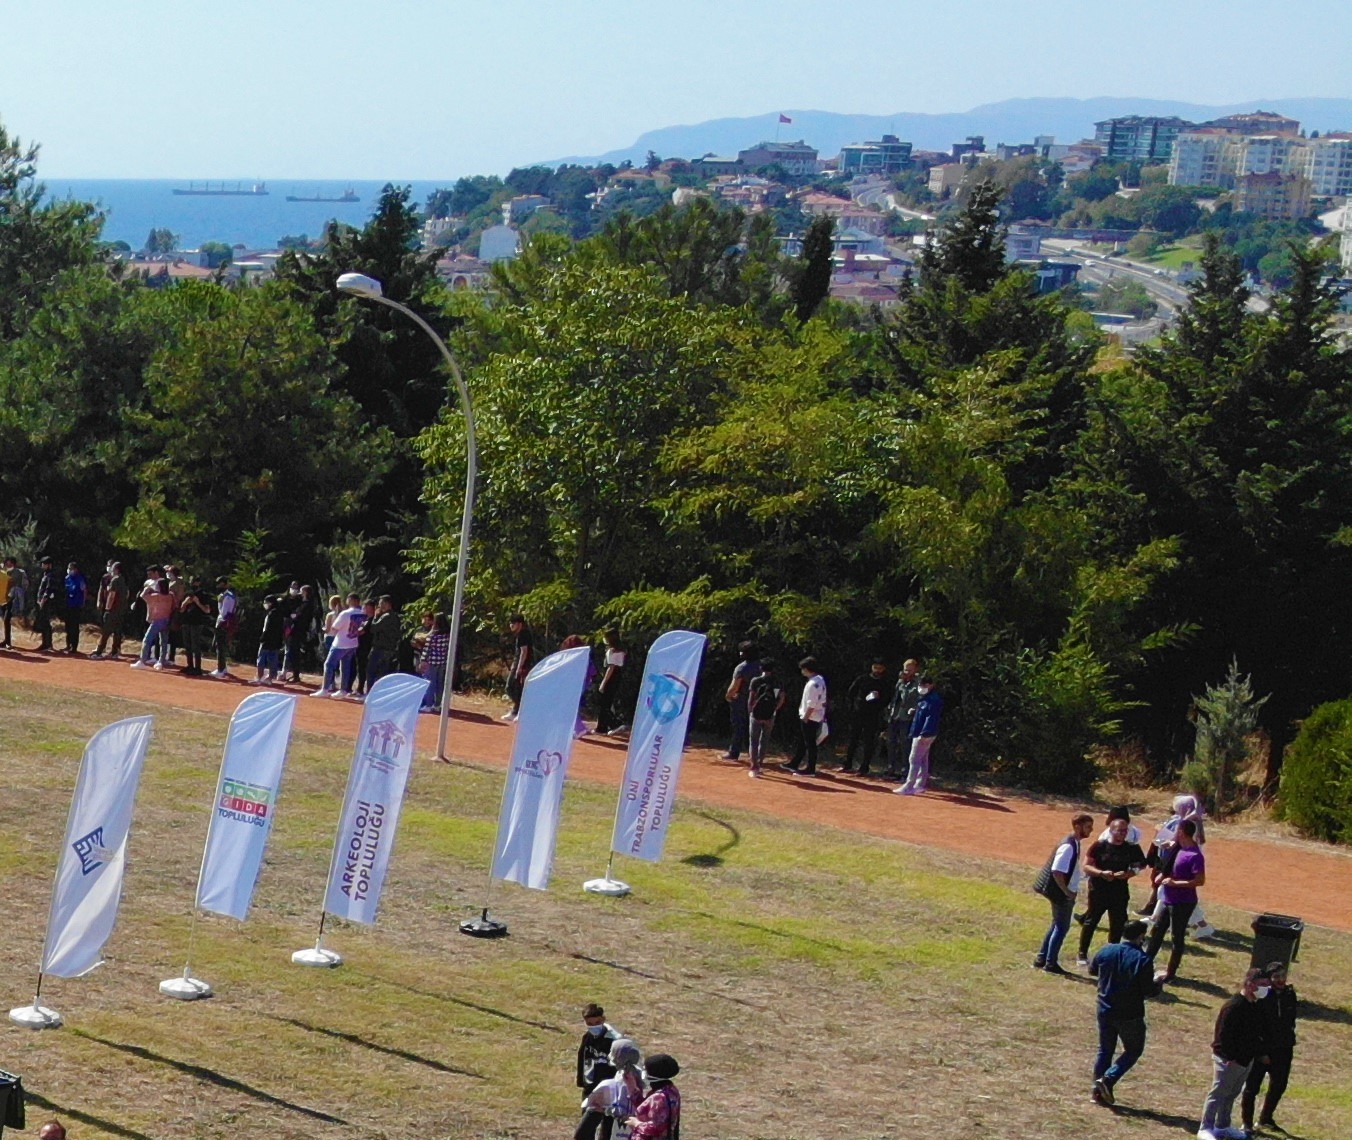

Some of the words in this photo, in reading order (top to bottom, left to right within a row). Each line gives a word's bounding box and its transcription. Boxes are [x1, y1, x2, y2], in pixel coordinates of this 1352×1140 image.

[631, 734, 663, 853] TRABZONSPORLULAR
[651, 765, 671, 832] TOPLULUĞU
[340, 800, 371, 897] ARKEOLOJİ
[354, 803, 385, 901] TOPLULUĞU
